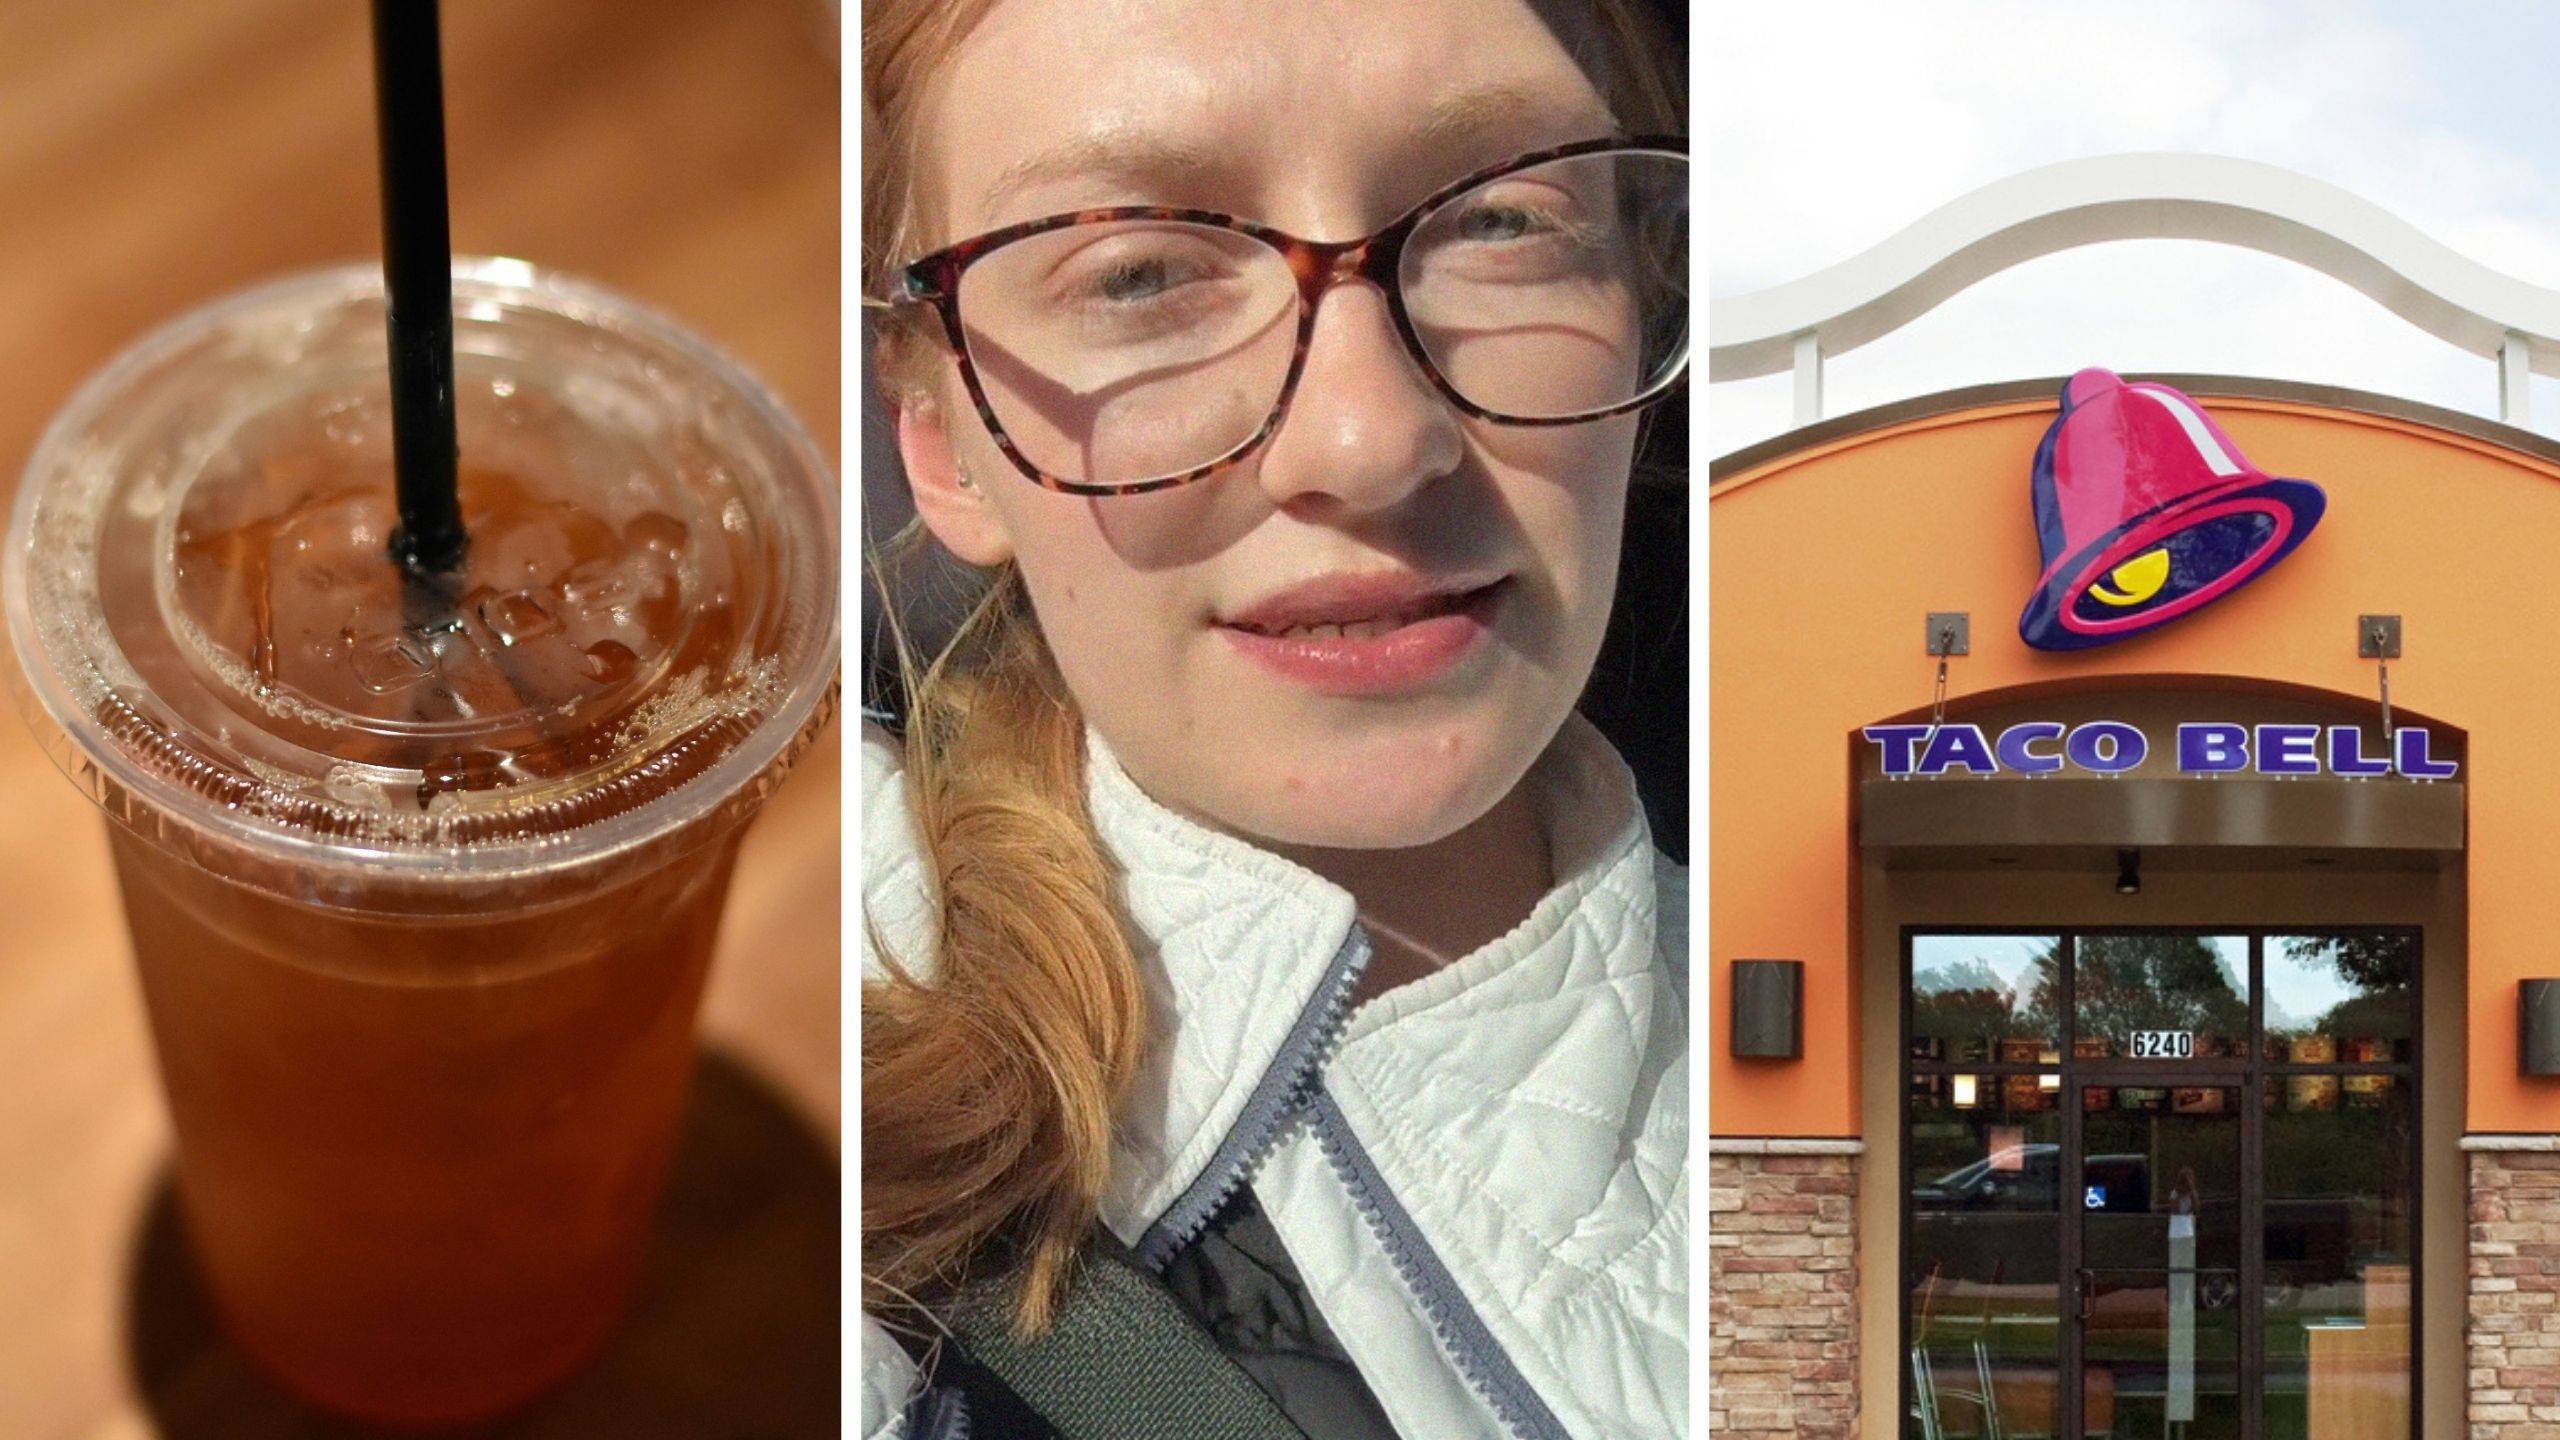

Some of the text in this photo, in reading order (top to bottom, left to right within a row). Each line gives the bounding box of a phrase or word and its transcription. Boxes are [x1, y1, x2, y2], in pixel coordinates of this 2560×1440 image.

[1862, 721, 2459, 779] TACO BELL
[2133, 1032, 2190, 1056] 6240
